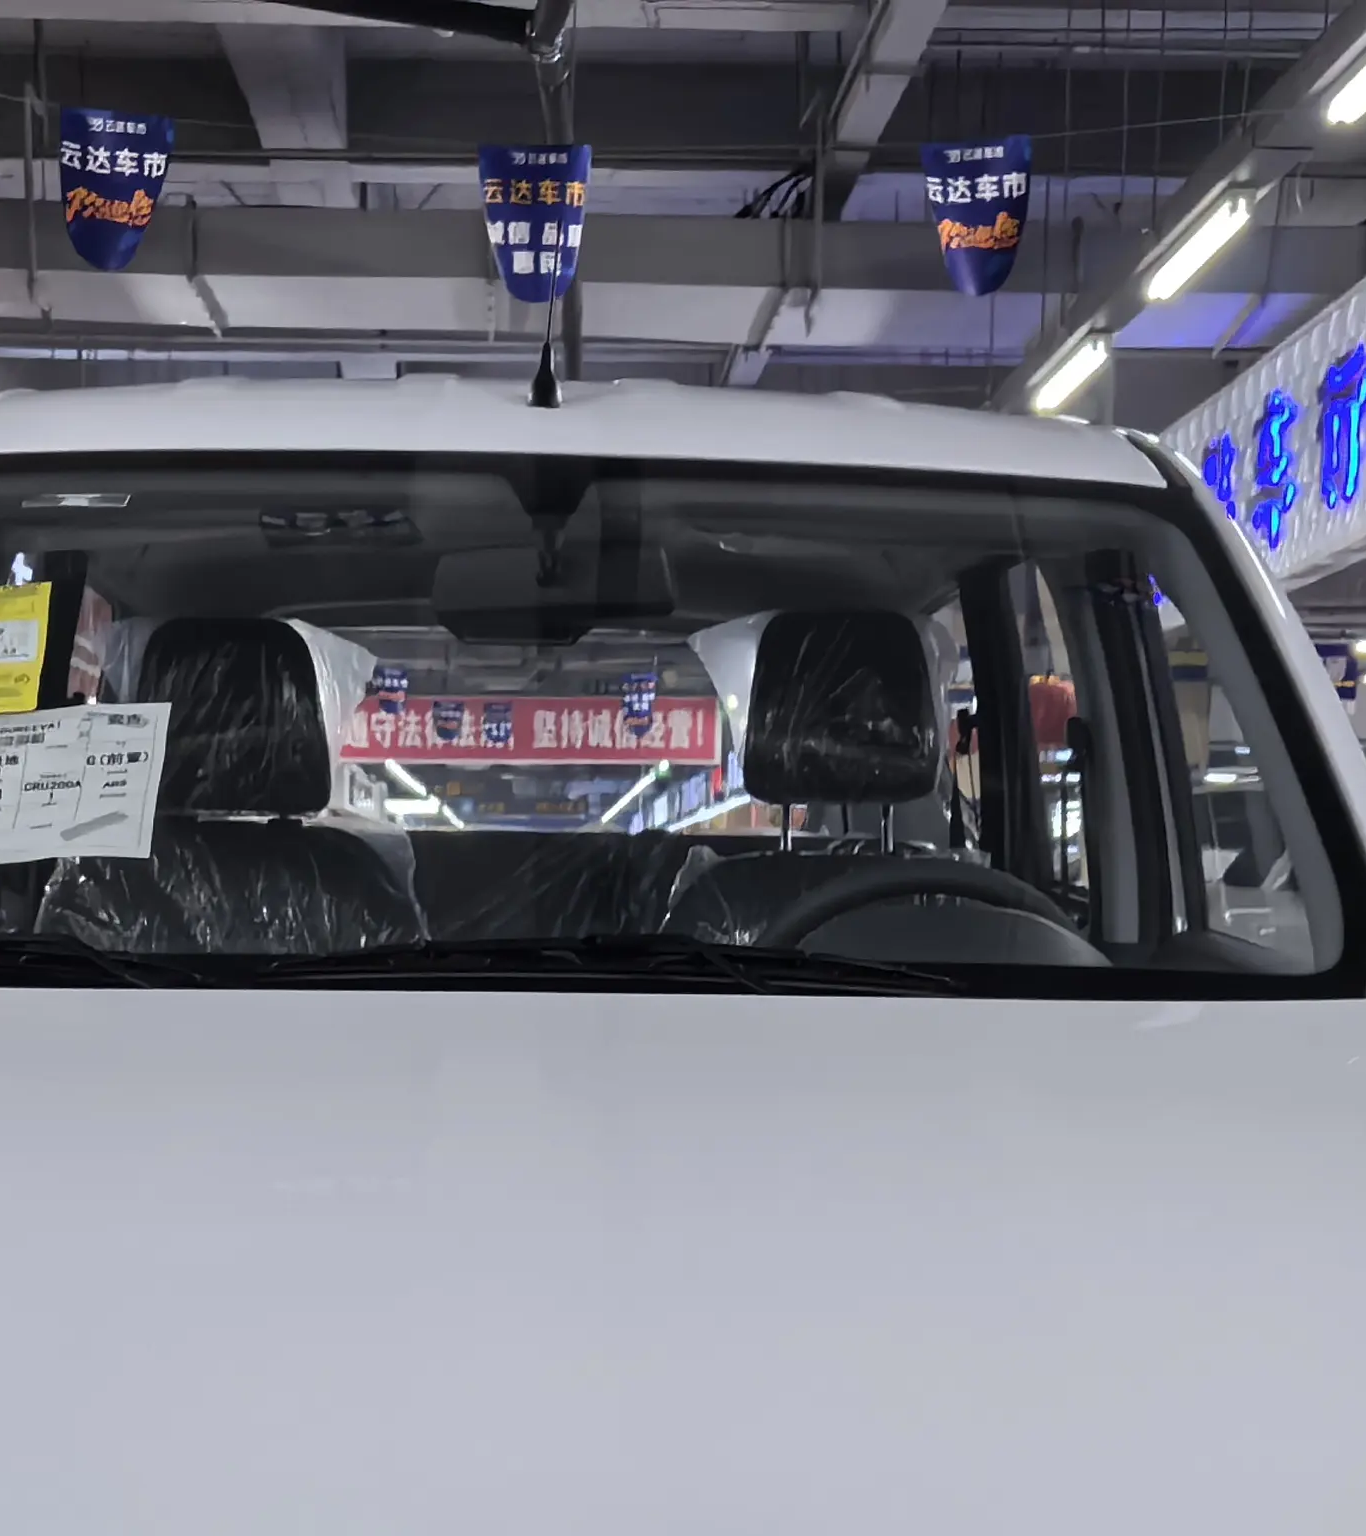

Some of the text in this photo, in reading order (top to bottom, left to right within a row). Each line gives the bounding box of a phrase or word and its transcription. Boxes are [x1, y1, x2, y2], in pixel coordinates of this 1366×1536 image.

[60, 140, 168, 179] 云达车市
[483, 178, 586, 208] 云达车市
[926, 172, 1028, 204] 云达车市
